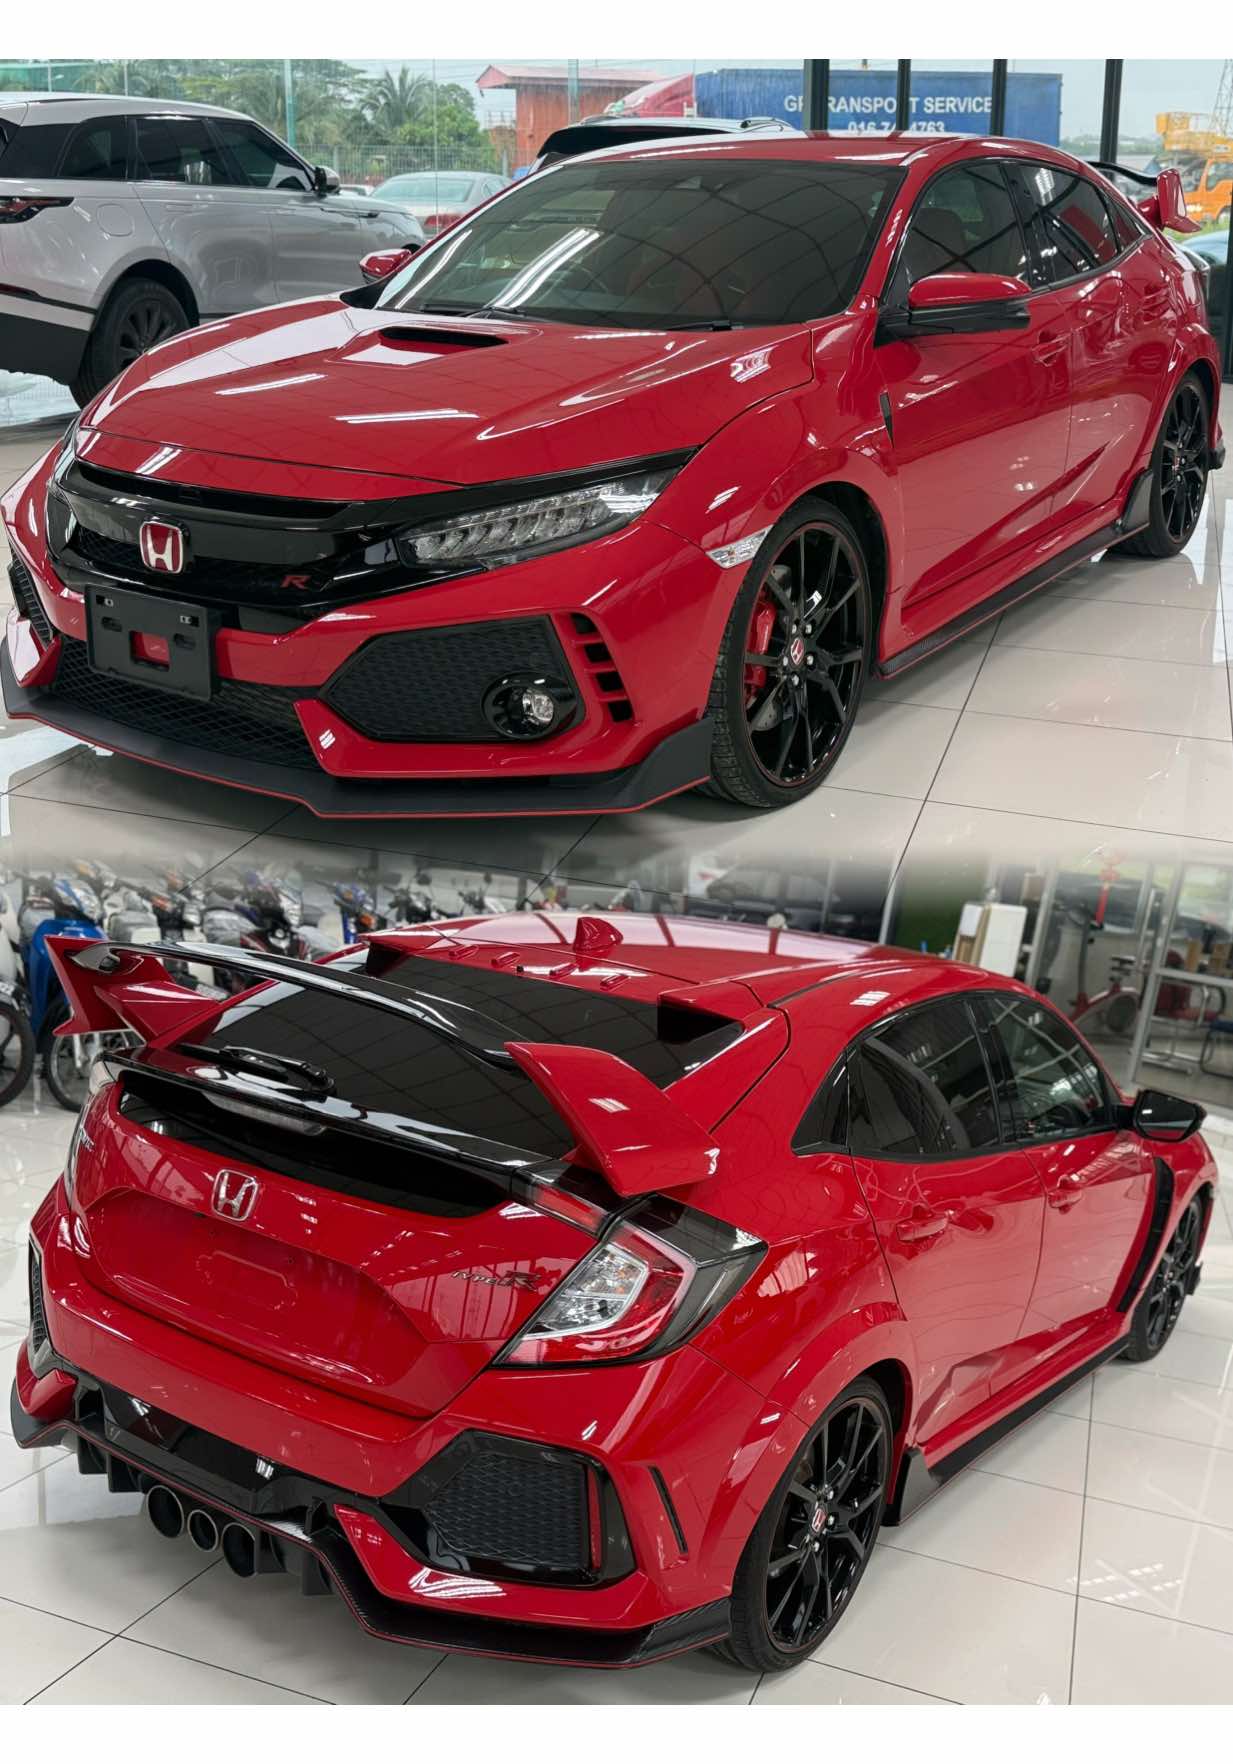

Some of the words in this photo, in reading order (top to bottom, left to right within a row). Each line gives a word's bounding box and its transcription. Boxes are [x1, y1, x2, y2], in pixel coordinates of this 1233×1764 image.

[826, 96, 920, 113] RANSPOT
[923, 97, 993, 113] SERVICE
[280, 575, 311, 590] R
